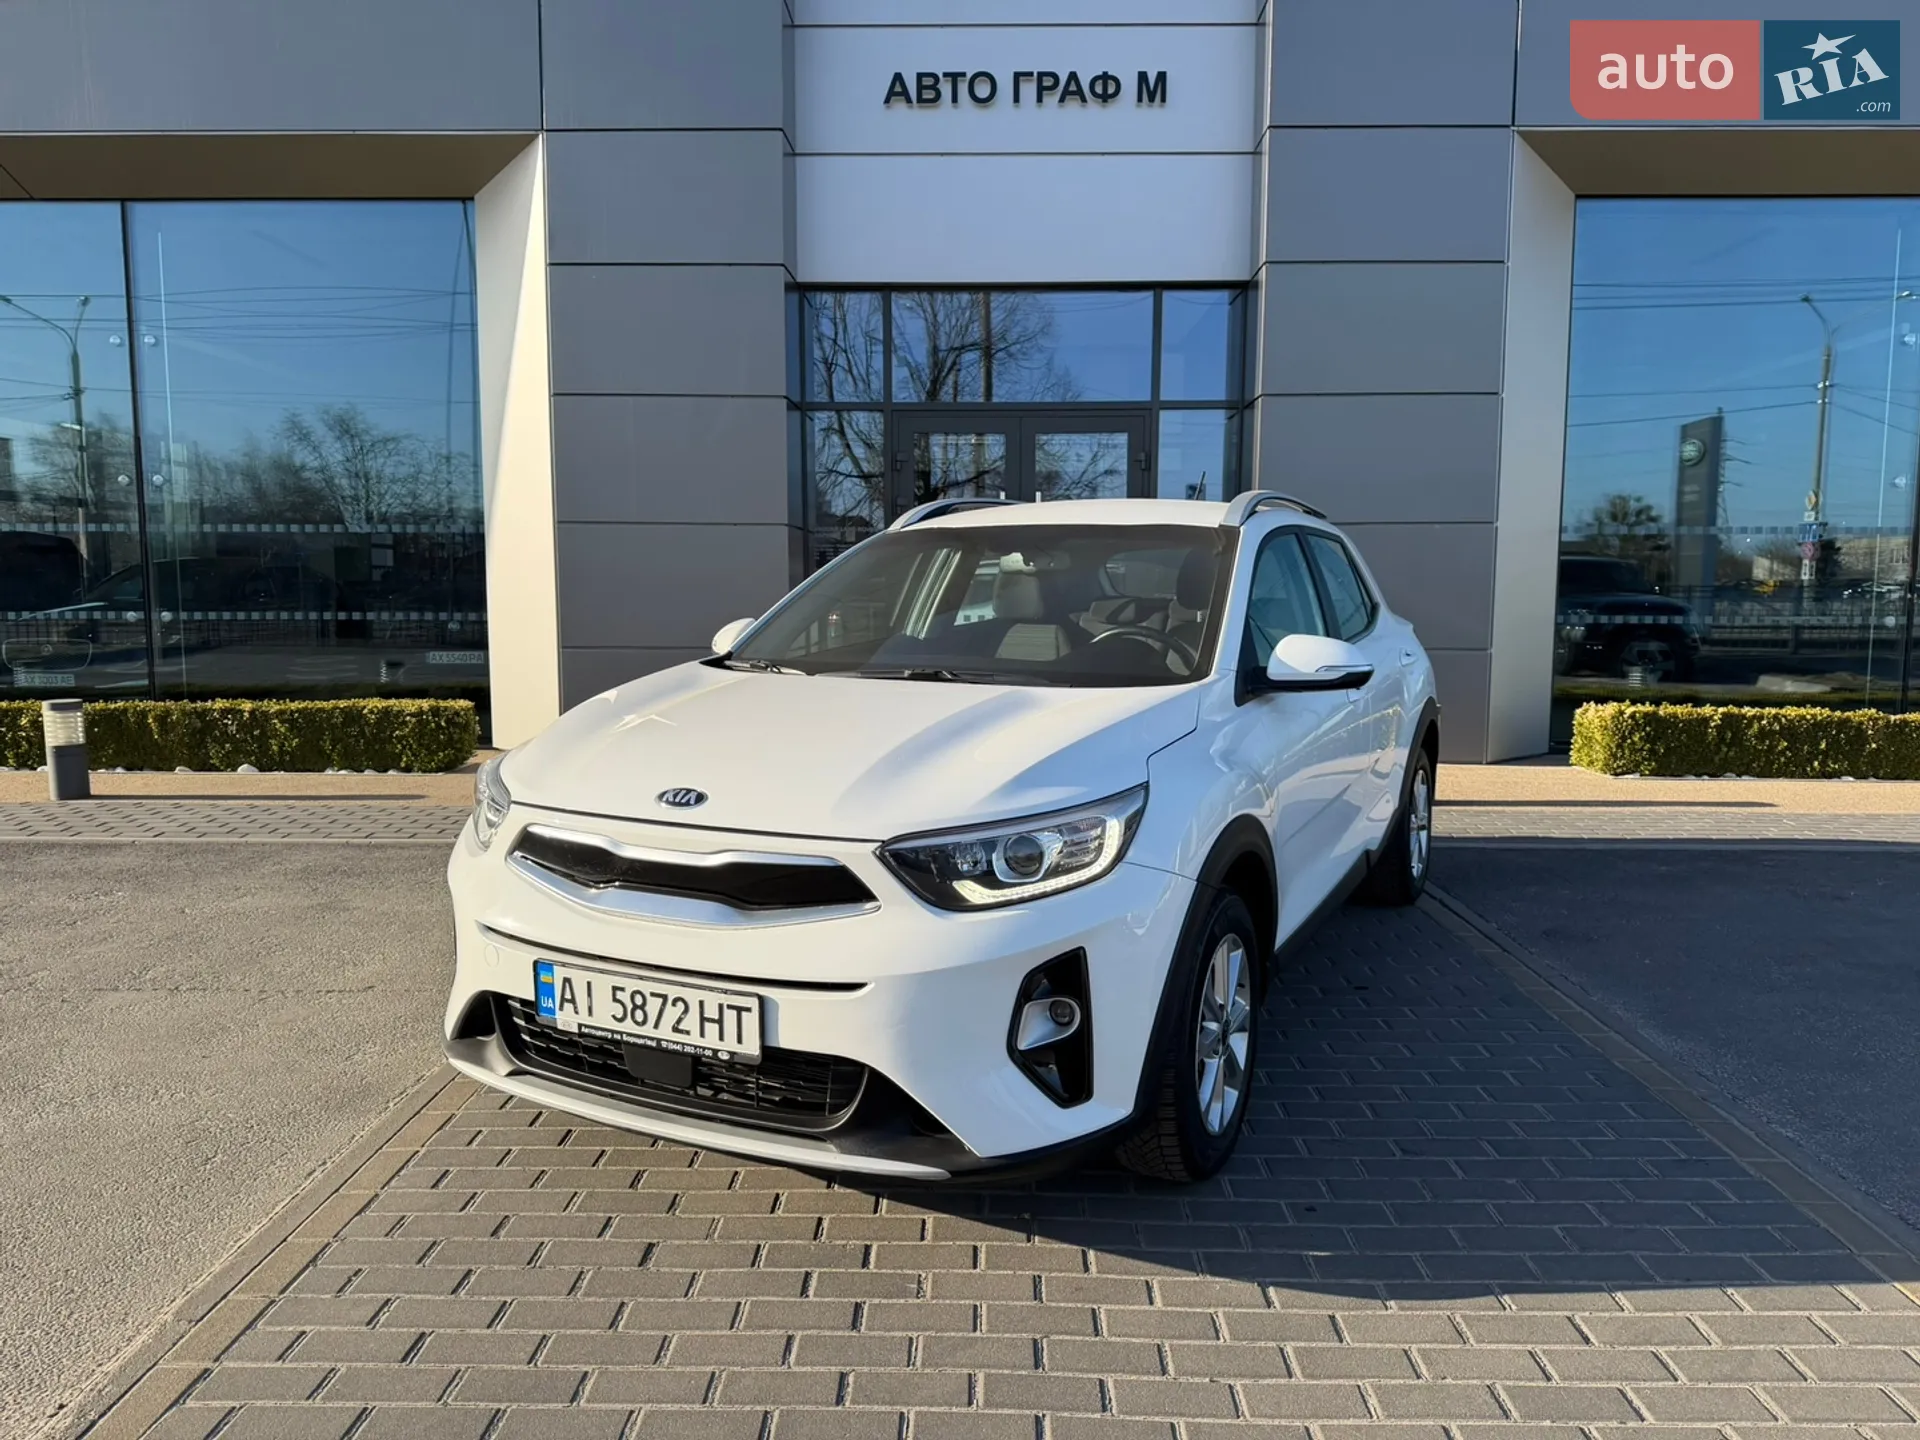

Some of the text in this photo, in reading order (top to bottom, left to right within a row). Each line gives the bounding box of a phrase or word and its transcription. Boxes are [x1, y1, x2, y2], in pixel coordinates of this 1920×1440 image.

[883, 71, 1168, 104] АВТО ГРАФ М
[661, 789, 699, 805] KIA
[542, 996, 554, 1008] UA
[559, 976, 752, 1044] AI 5872 HT
